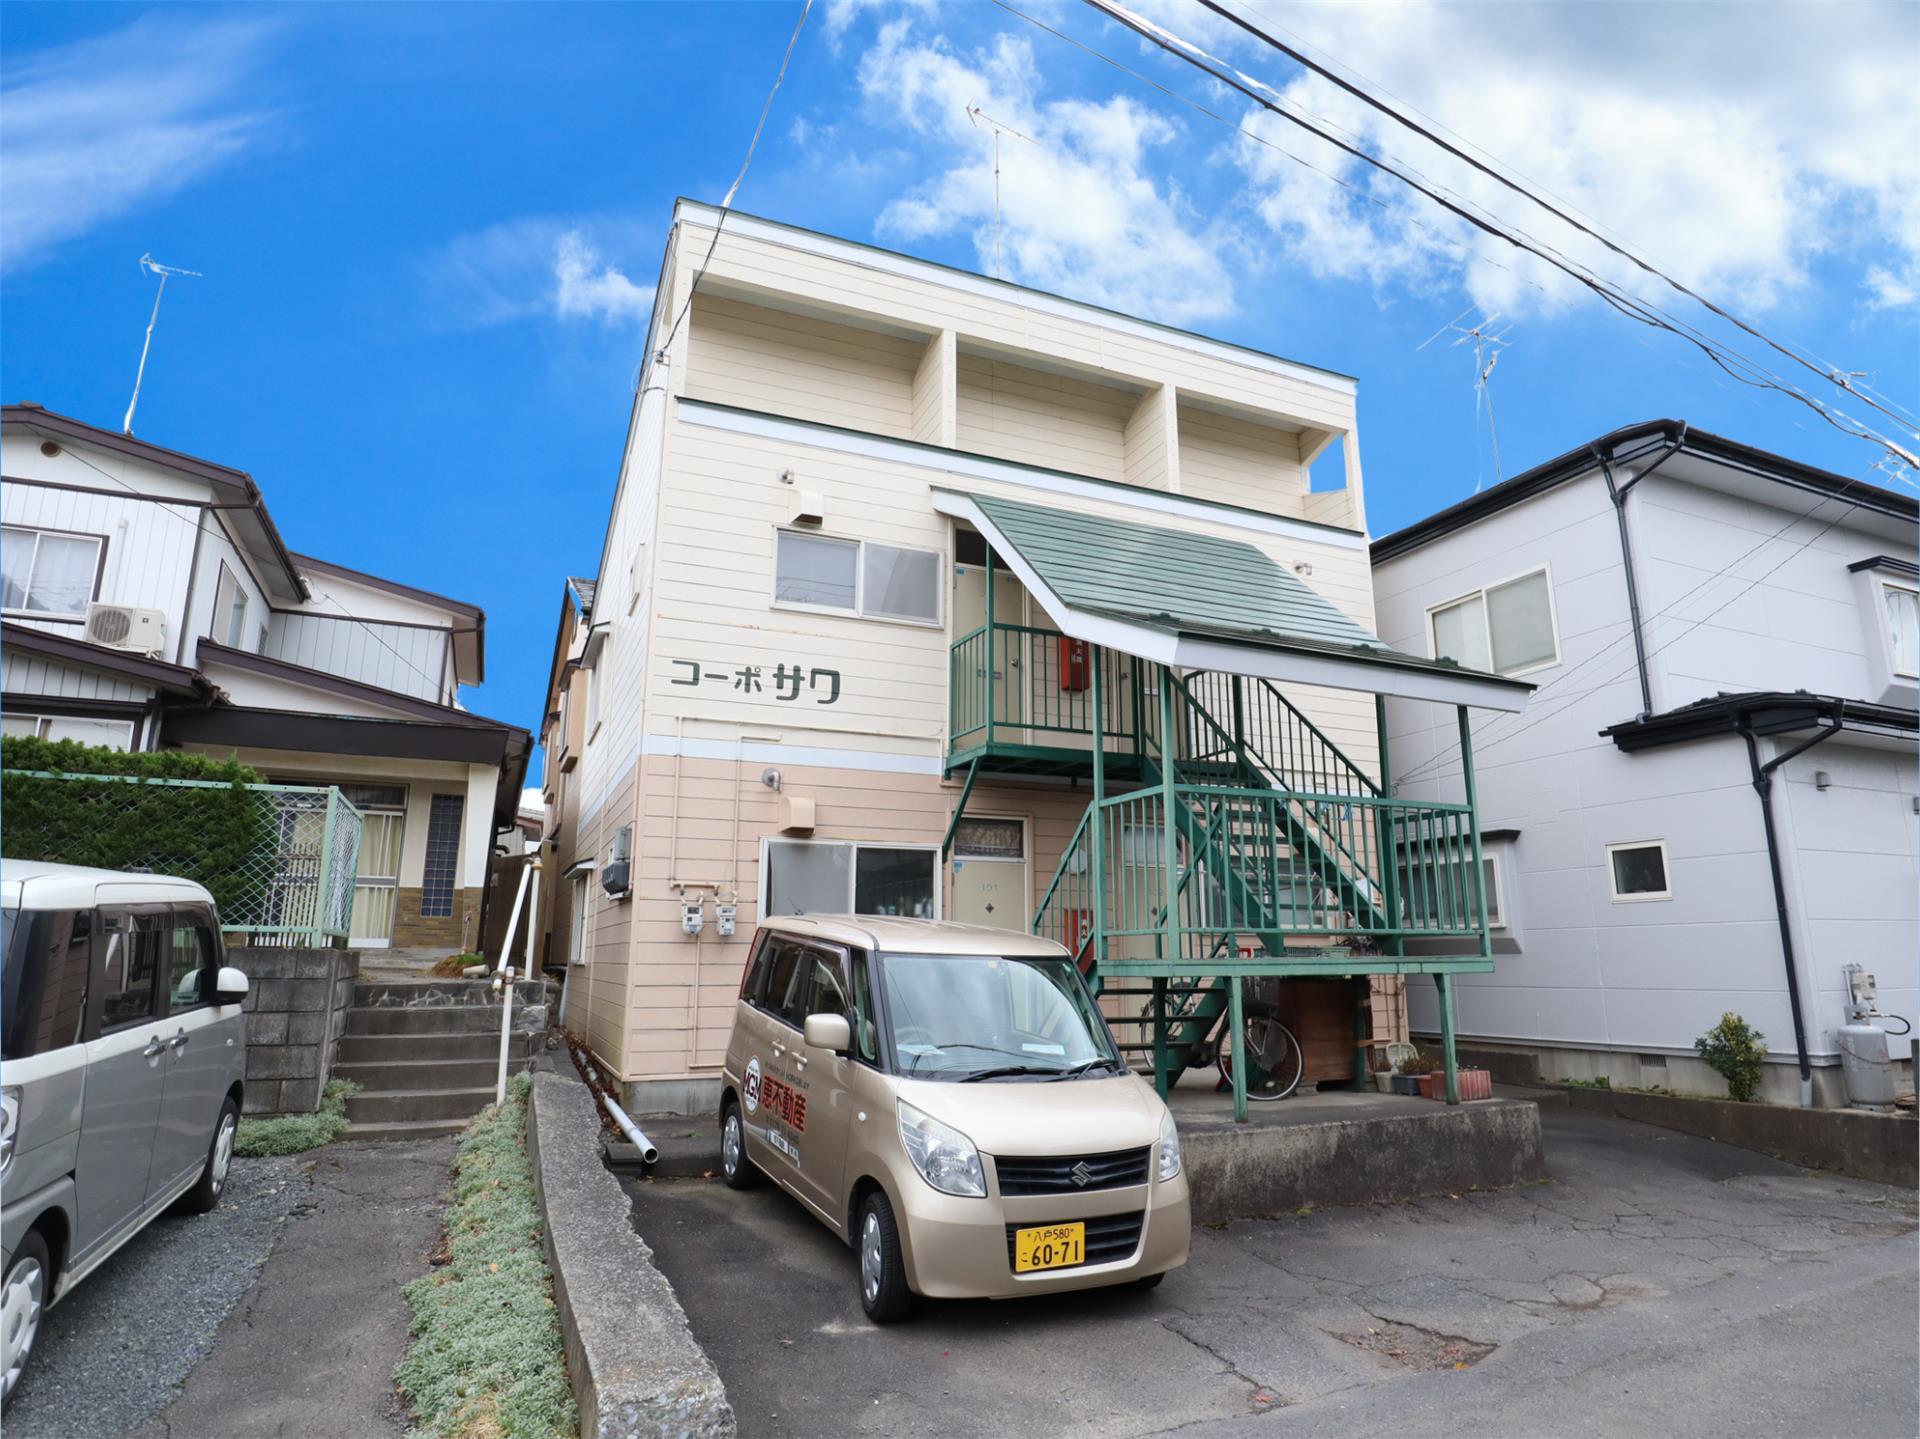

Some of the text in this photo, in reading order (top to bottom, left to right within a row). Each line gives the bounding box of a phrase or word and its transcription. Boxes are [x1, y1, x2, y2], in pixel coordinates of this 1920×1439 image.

[671, 660, 841, 704] コーポサワ
[1032, 1240, 1078, 1266] 60-71
